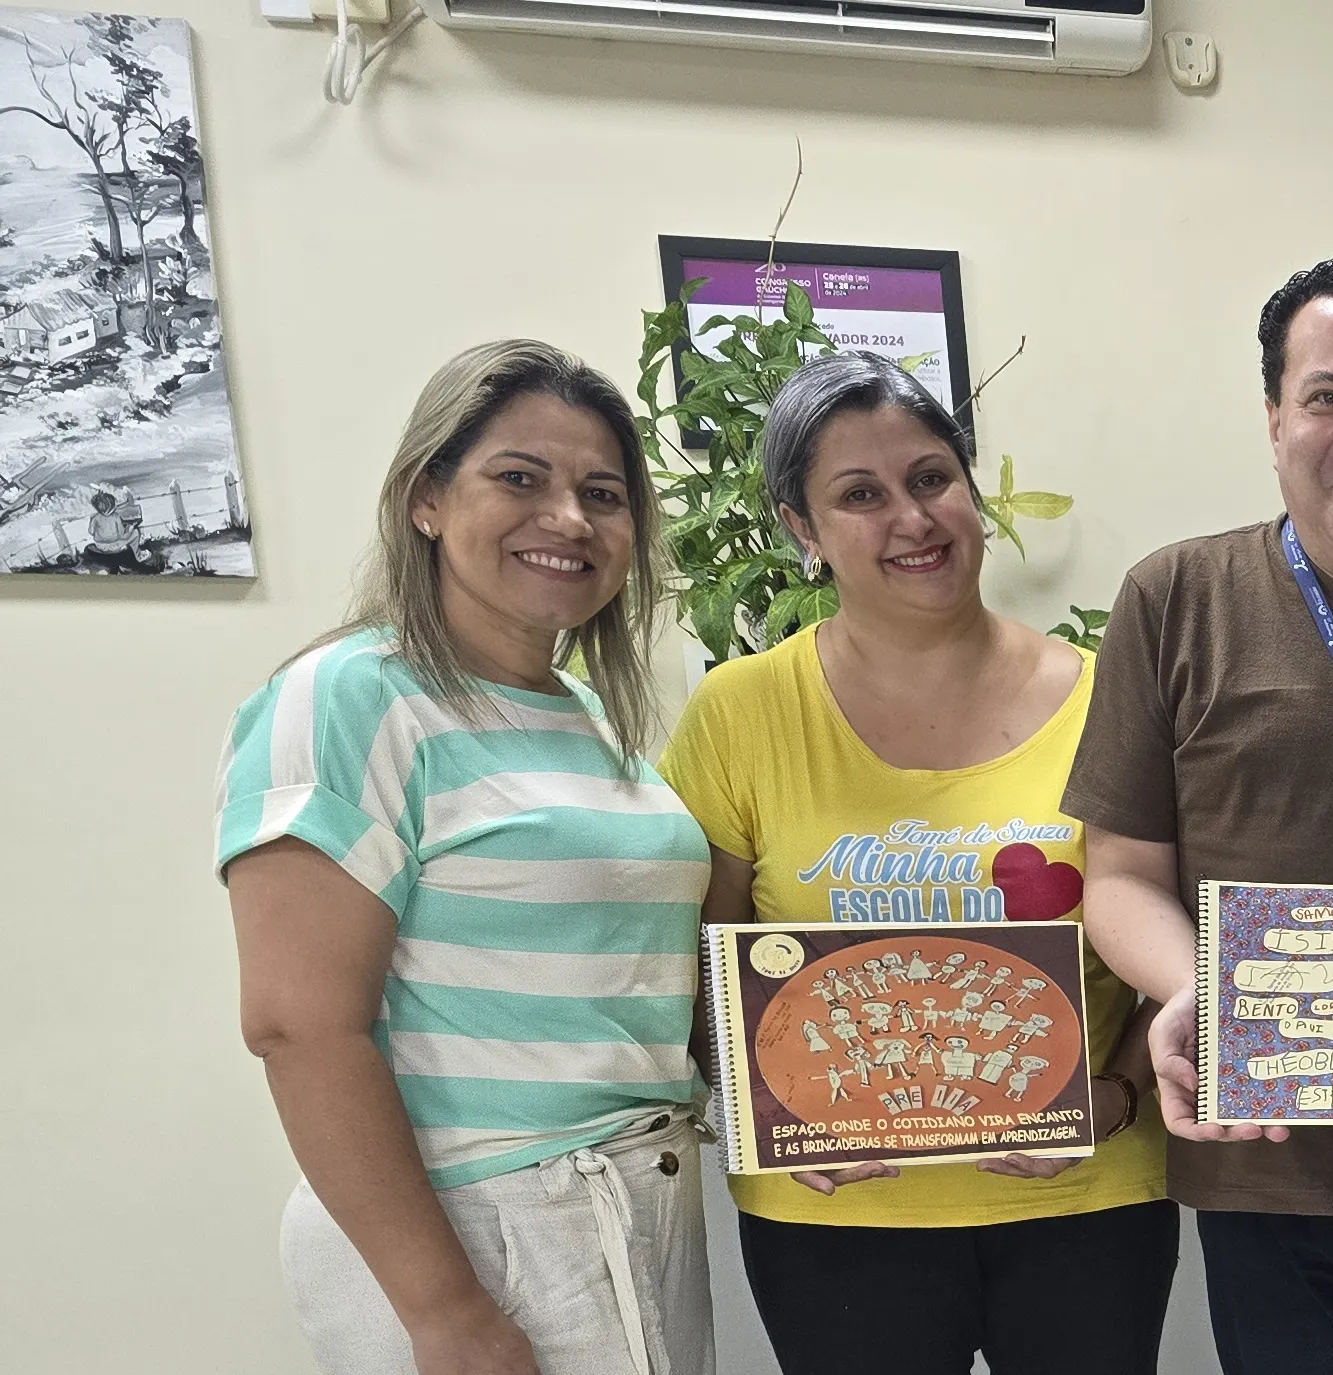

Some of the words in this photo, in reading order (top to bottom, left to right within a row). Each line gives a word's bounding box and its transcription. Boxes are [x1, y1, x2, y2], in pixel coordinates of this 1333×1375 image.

[872, 334, 905, 347] 2024
[885, 818, 959, 847] Tomé
[962, 823, 994, 844] de
[996, 818, 1072, 843] Souza
[797, 834, 983, 884] Minha
[829, 886, 952, 922] ESCOLA
[960, 886, 1004, 922] DO
[1238, 998, 1297, 1018] BENTO
[882, 1090, 921, 1110] PRE
[772, 1122, 827, 1139] ESPAÇO
[831, 1118, 872, 1133] ONDE
[877, 1118, 888, 1130] O
[893, 1115, 975, 1130] COTIDIANO
[978, 1115, 1015, 1127] VIRA
[1016, 1109, 1084, 1125] ENCANTO
[774, 1143, 782, 1158] E
[785, 1142, 800, 1156] AS
[802, 1137, 880, 1154] BRINCADEIRAS
[884, 1135, 897, 1148] SE
[900, 1133, 979, 1148] TRANSFORMAM
[981, 1131, 997, 1145] EM
[1000, 1125, 1081, 1143] APRENDIZAGEM.
